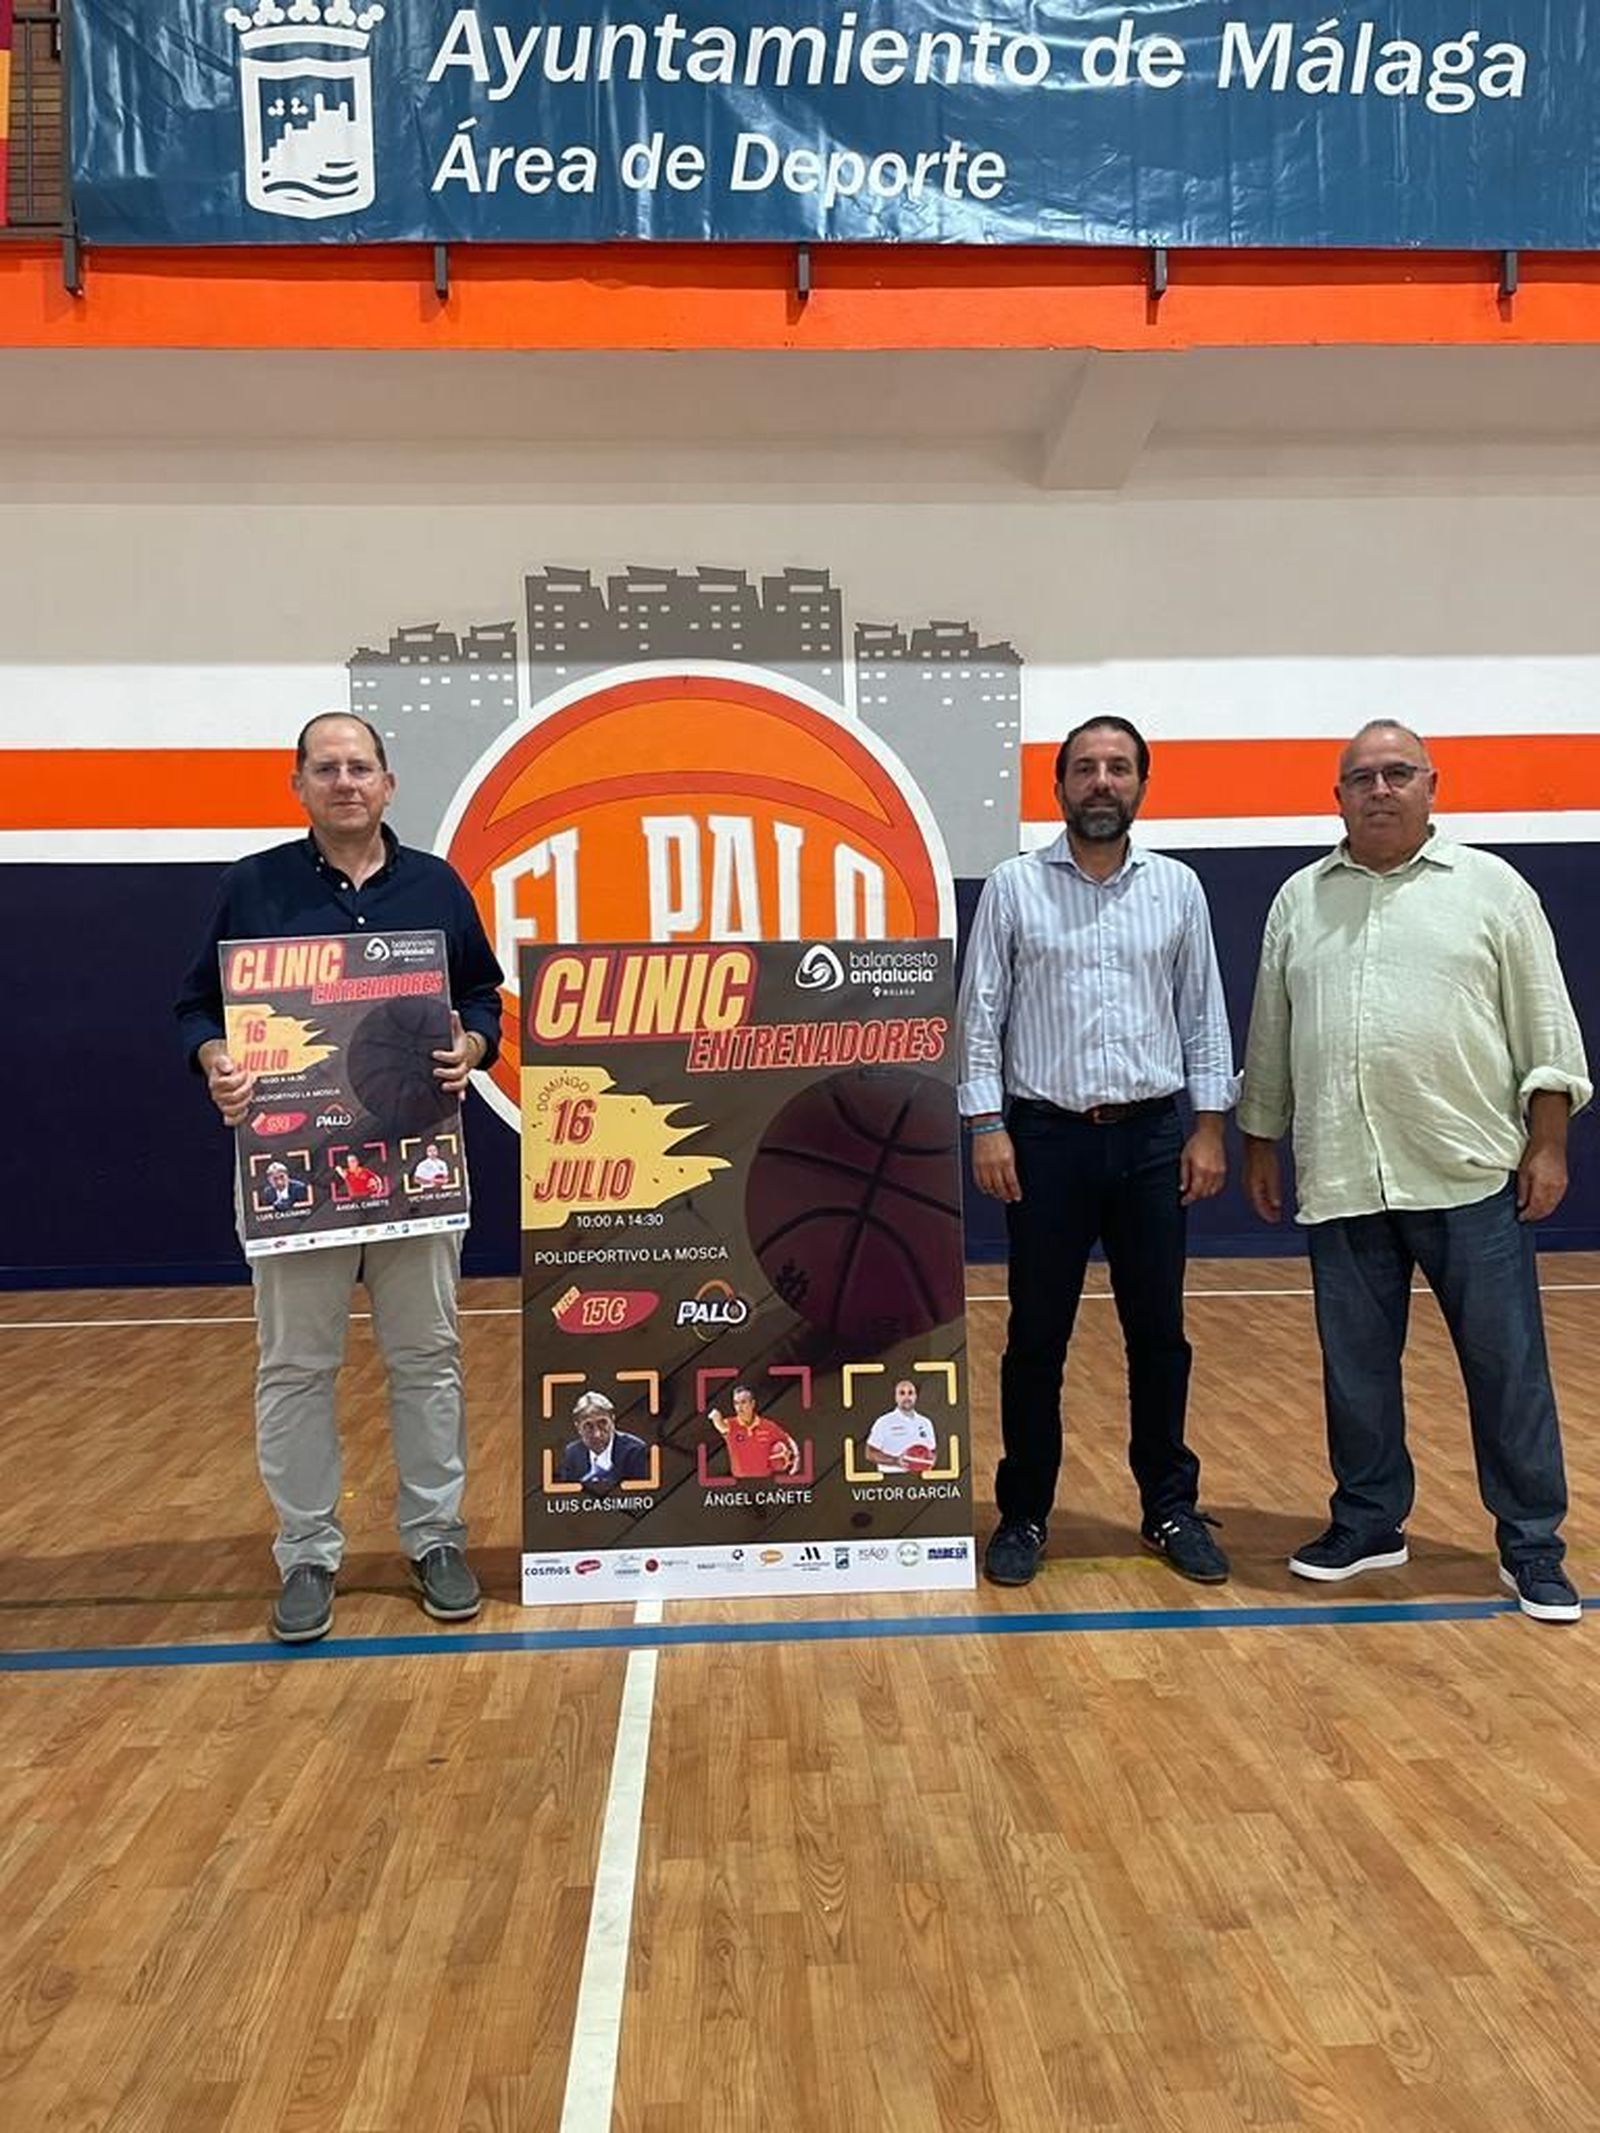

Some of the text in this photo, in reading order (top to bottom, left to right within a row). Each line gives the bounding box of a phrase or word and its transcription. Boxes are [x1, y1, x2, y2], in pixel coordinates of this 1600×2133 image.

[427, 9, 1529, 115] Ayuntamiento de Málaga
[431, 117, 1007, 208] Área de Deporte
[641, 813, 887, 943] PALO
[231, 944, 343, 992] CLINIC
[849, 950, 938, 968] baloncesto
[311, 971, 444, 1005] ENTRENADORES
[533, 950, 753, 1040] CLINIC
[244, 1019, 268, 1044] 16
[687, 1017, 948, 1072] ENTRENADORES
[237, 1049, 290, 1072] JULIO
[537, 1076, 591, 1113] DOMINGO
[551, 1096, 597, 1146] 16
[533, 1156, 636, 1203] JULIO
[577, 1213, 664, 1228] 10:00 A 14:30
[535, 1246, 729, 1265] POLIDEPORTIVO LA MOSCA
[546, 1494, 655, 1513] LUIS CASIMIRO
[703, 1487, 813, 1507] ÁNGEL CAÑETE
[852, 1481, 960, 1503] VICTOR GARCÍA
[524, 1565, 571, 1577] cosmos
